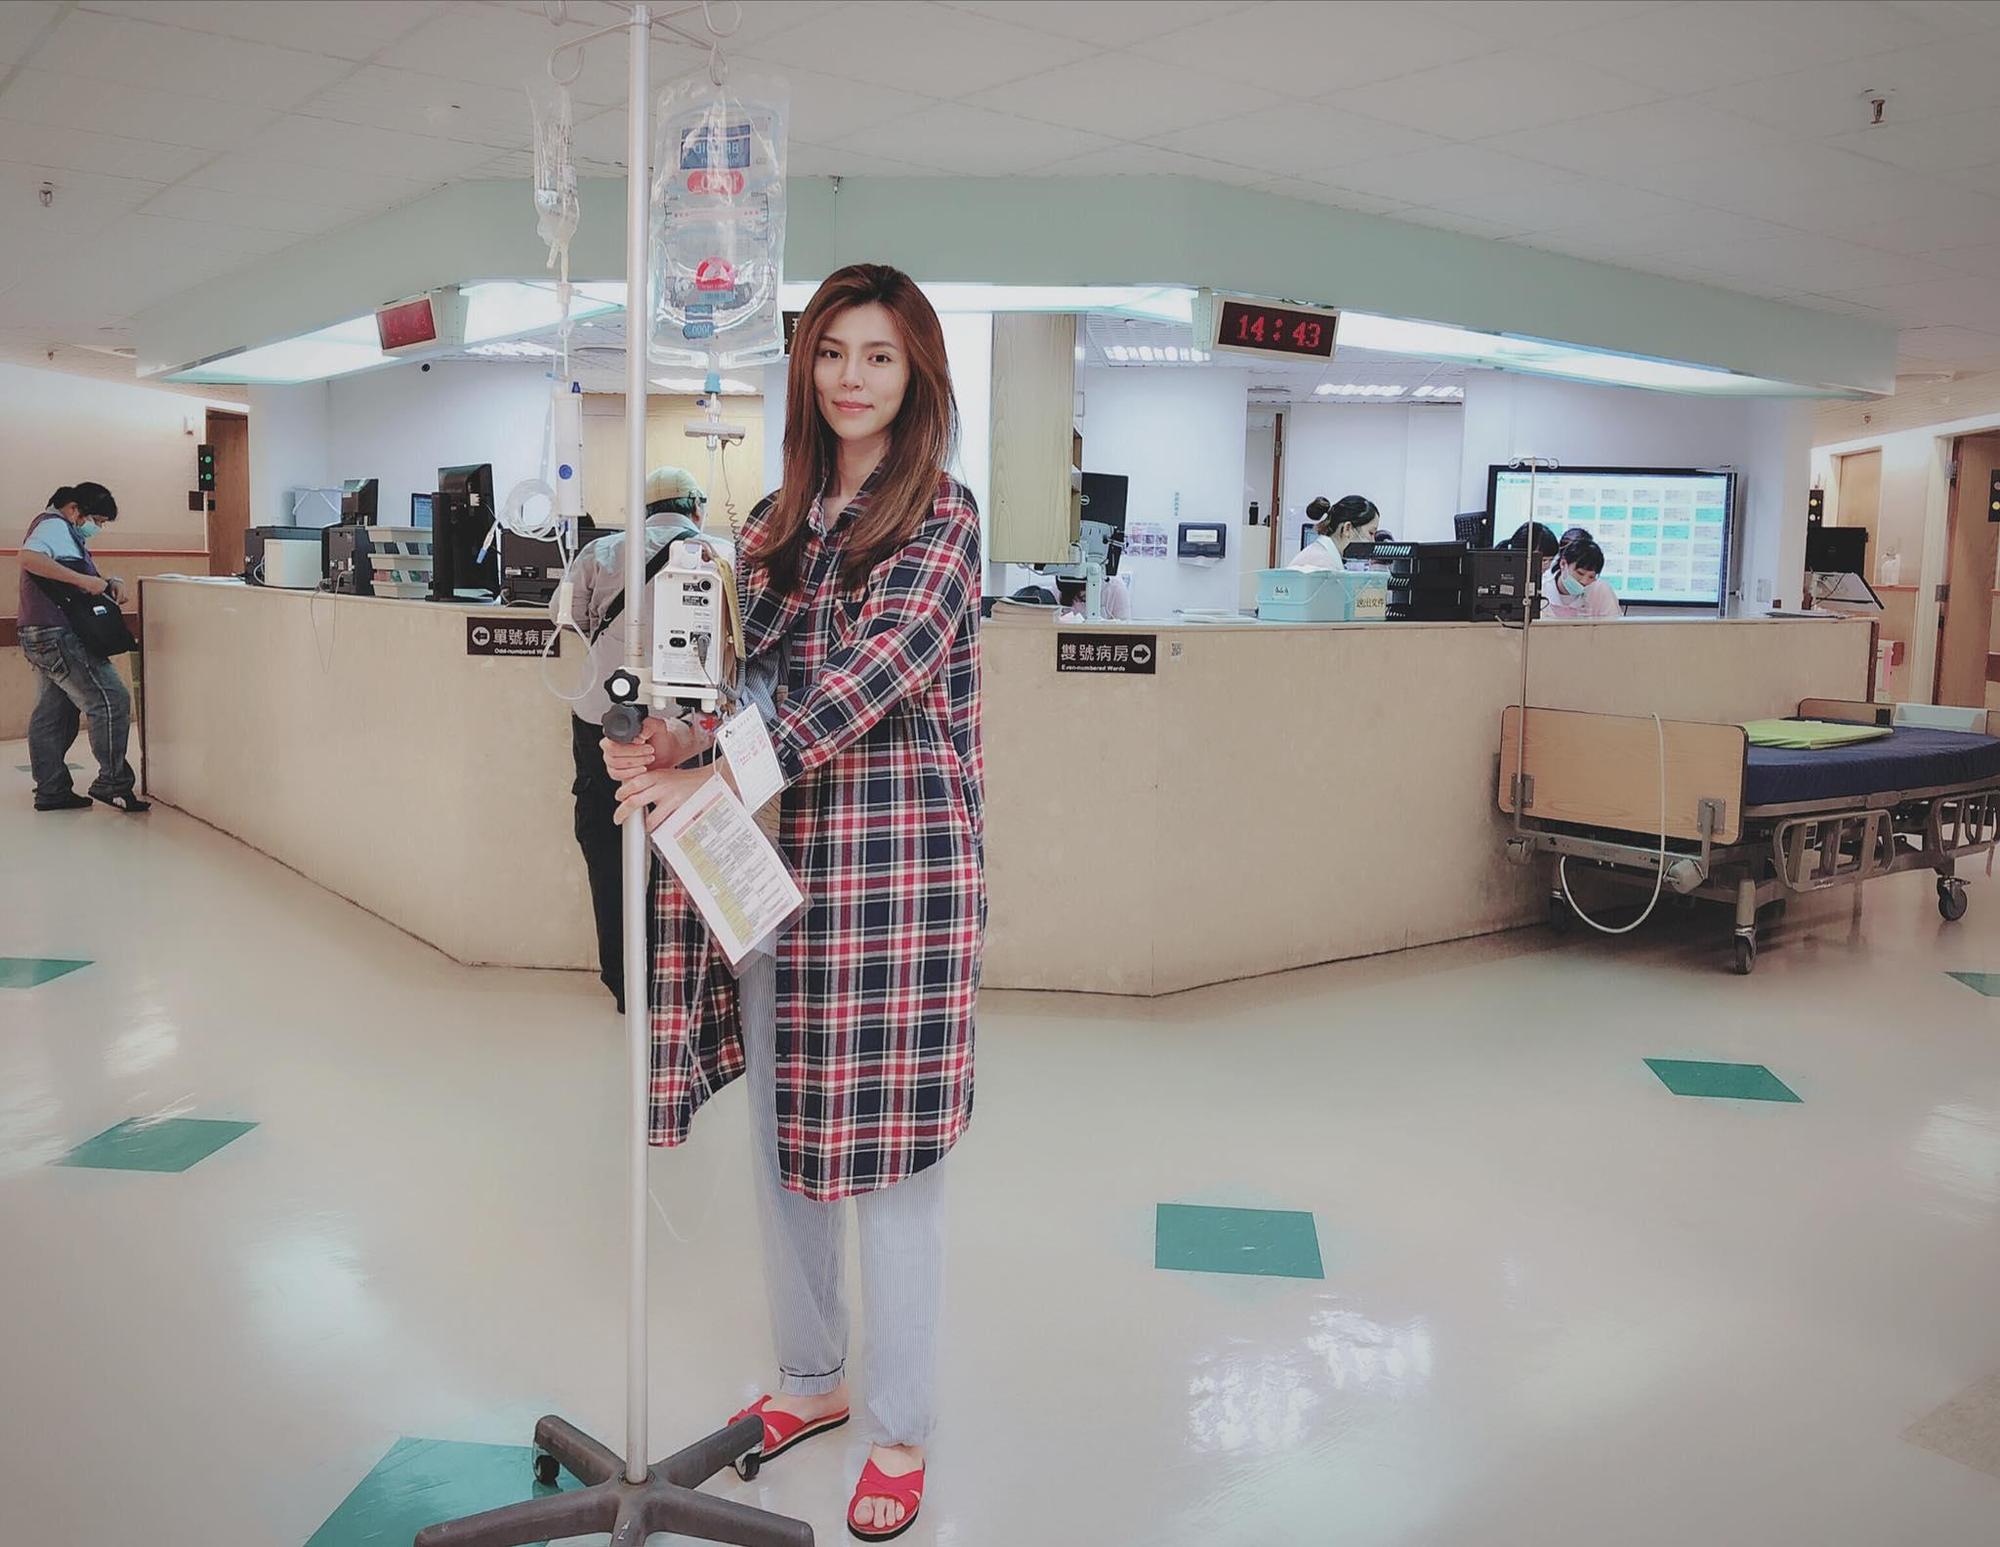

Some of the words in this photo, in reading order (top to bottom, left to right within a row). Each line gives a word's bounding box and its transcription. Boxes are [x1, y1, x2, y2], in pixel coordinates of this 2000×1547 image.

[1237, 314, 1321, 348] 14:43
[494, 647, 536, 655] Odd-numbered
[1061, 643, 1129, 662] 雙號病房
